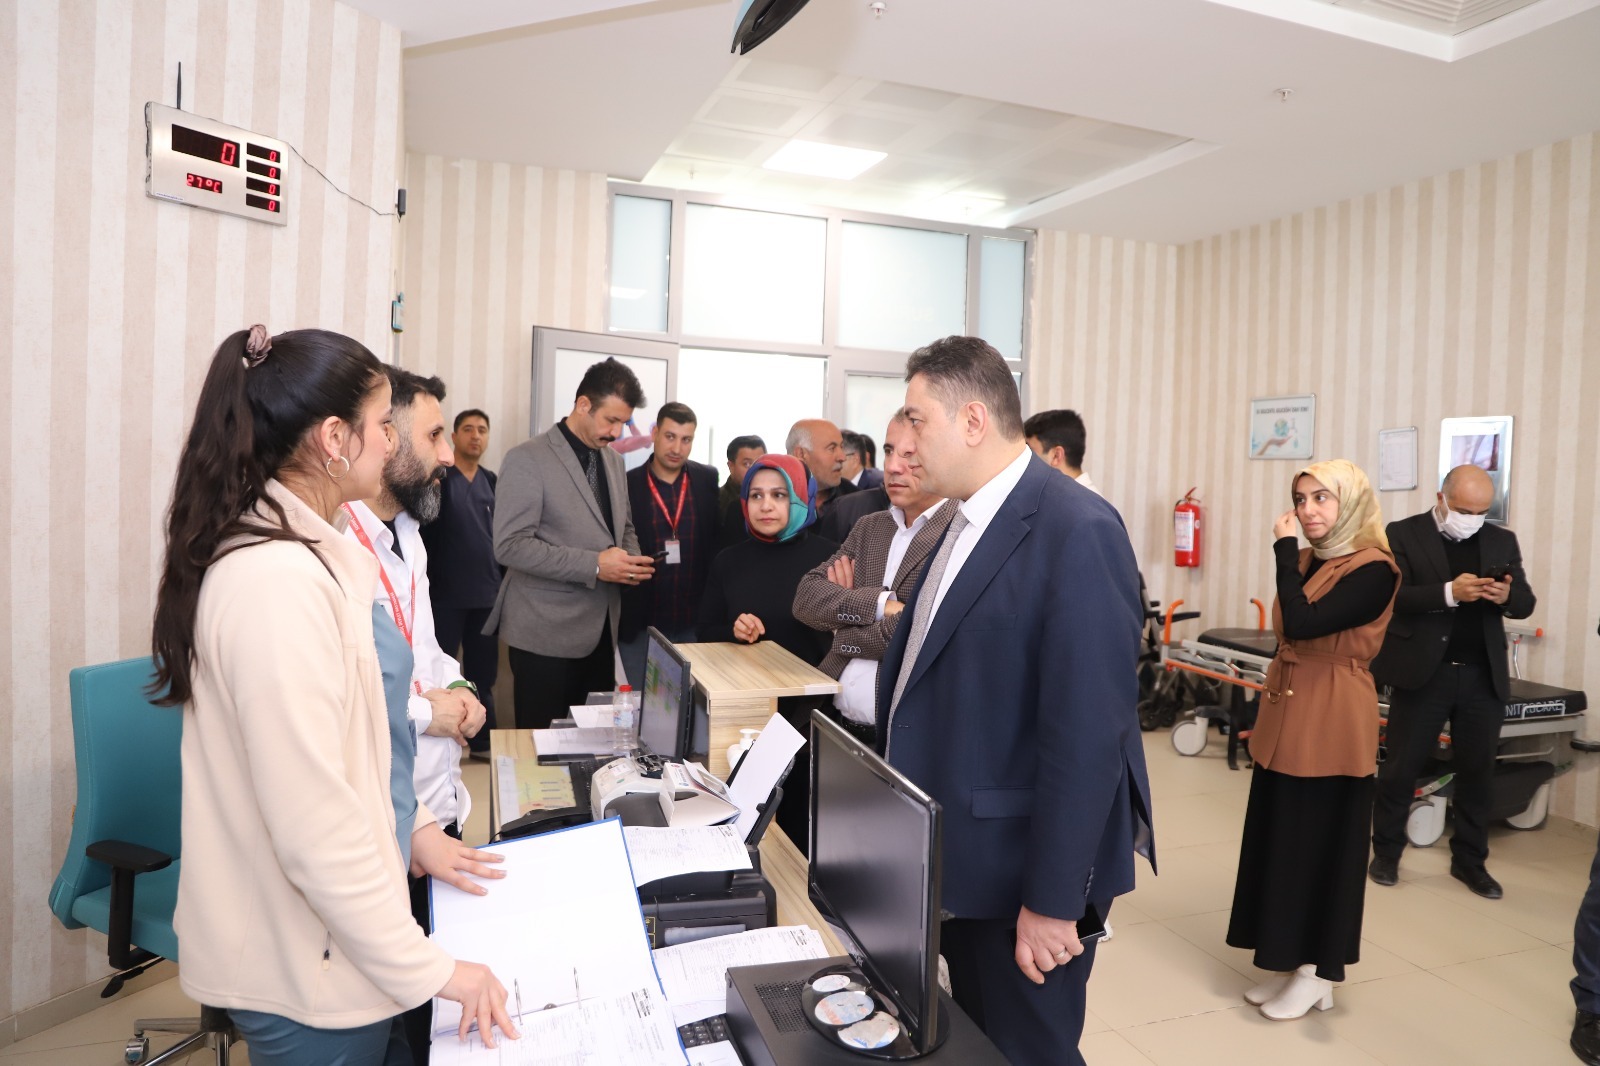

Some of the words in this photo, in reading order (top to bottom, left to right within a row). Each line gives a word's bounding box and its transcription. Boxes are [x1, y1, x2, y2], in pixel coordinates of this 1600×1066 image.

[221, 142, 236, 166] 0
[269, 151, 277, 162] 0
[269, 168, 276, 179] 0
[268, 184, 276, 195] 0
[268, 200, 275, 211] 0
